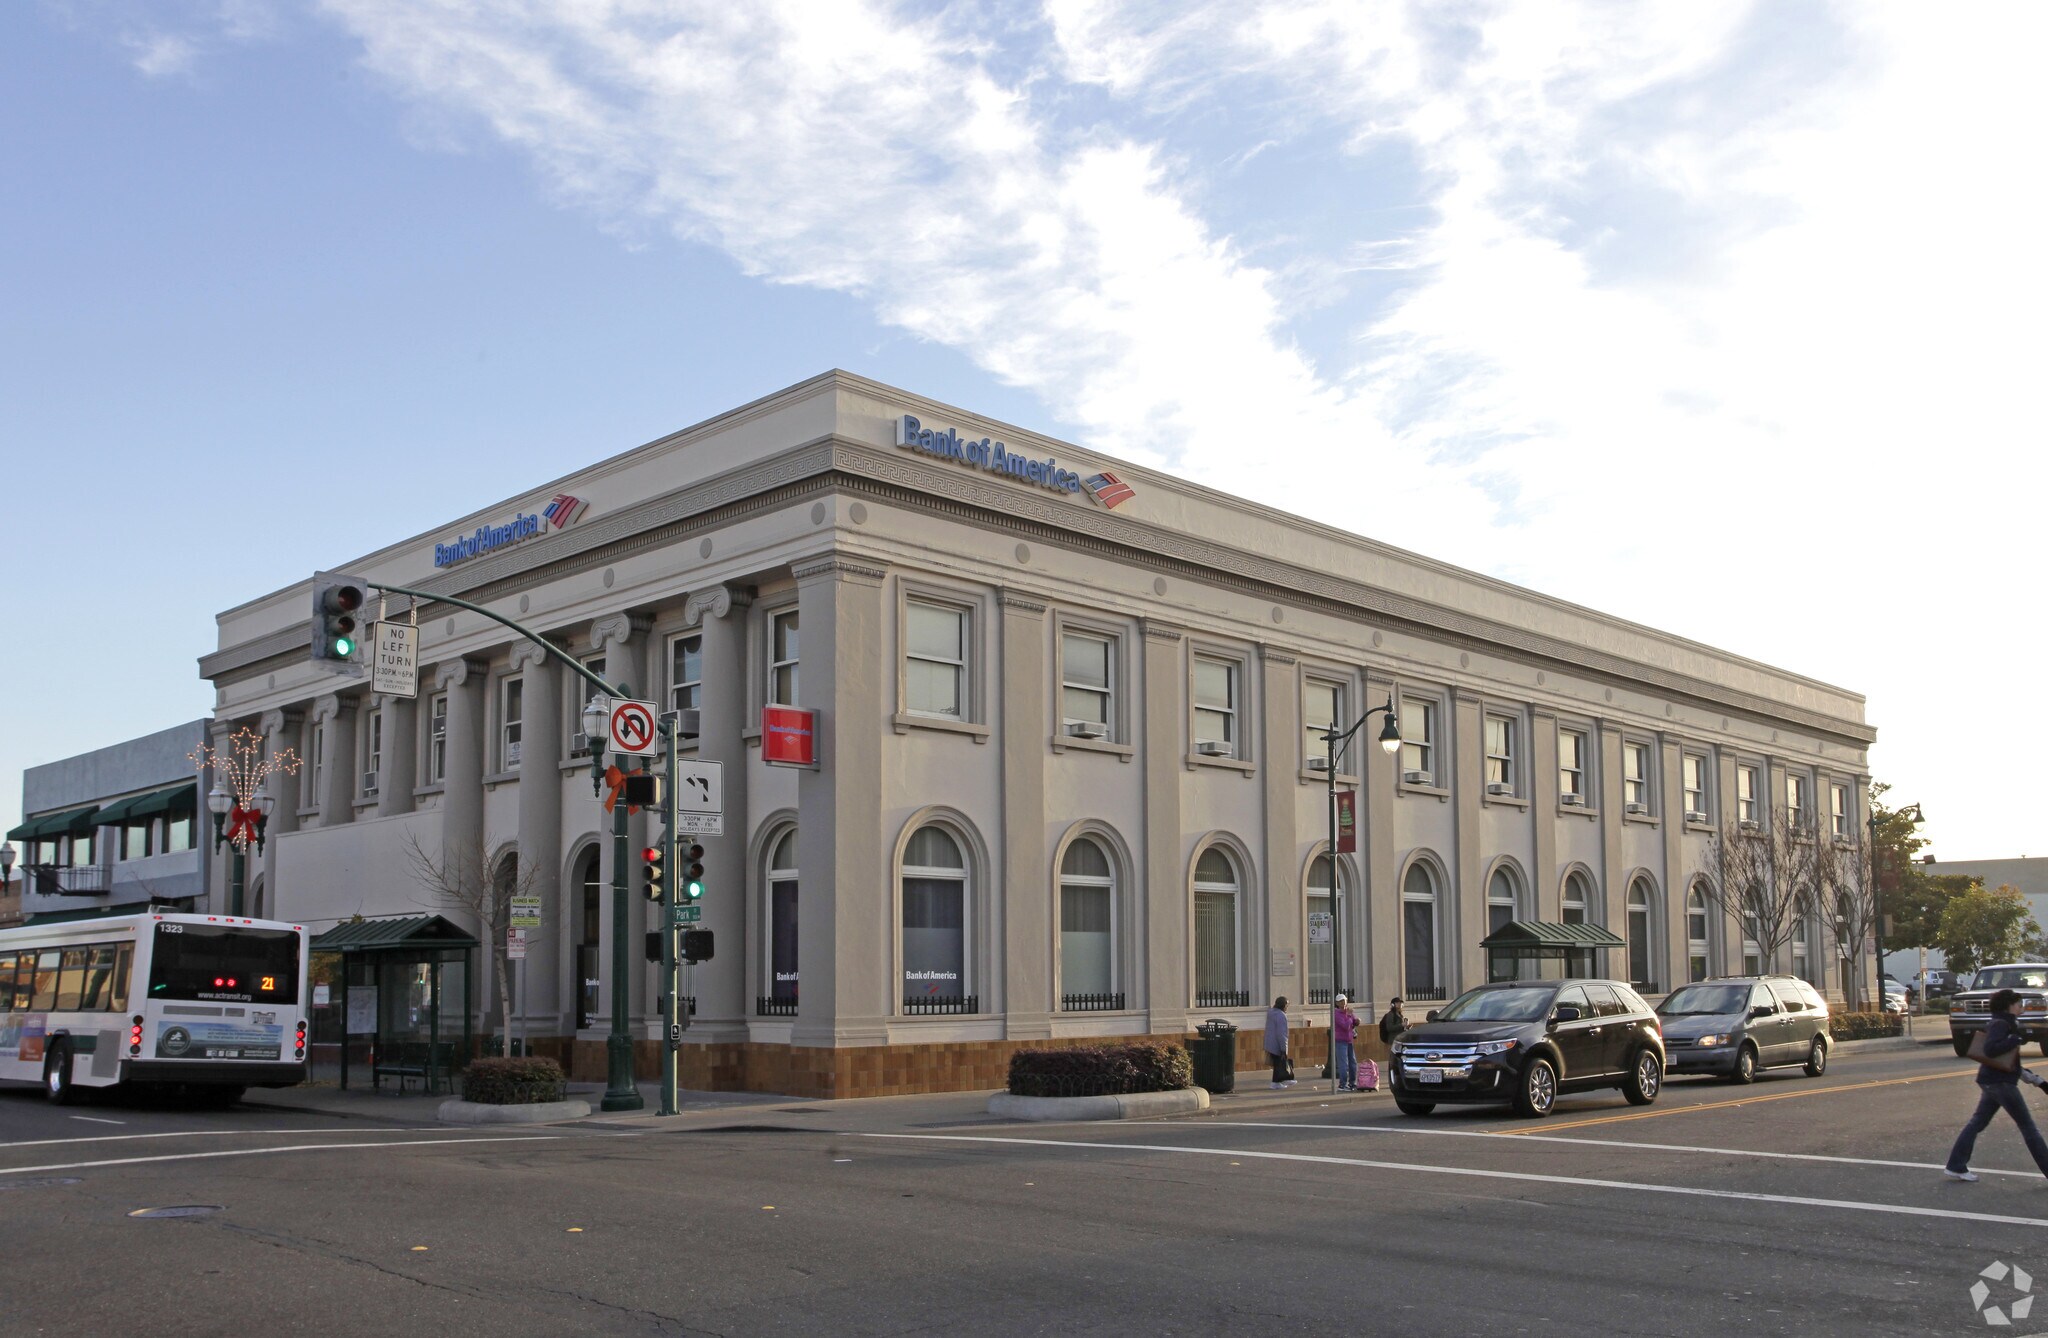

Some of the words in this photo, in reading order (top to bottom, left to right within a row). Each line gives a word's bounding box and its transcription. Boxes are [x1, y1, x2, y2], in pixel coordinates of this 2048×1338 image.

[903, 414, 964, 459] Bank
[966, 437, 991, 468] of
[991, 441, 1080, 494] America
[434, 535, 468, 568] Bank
[466, 526, 482, 556] of
[481, 512, 538, 551] America
[390, 629, 405, 639] NO
[382, 641, 411, 653] LEFT
[381, 654, 412, 667] TURN
[676, 909, 690, 920] Park
[160, 923, 183, 934] 1323
[776, 972, 790, 981] Bank
[790, 972, 796, 981] of
[905, 970, 923, 980] Bank
[922, 970, 930, 980] of
[930, 970, 957, 980] America
[261, 976, 274, 990] 21
[585, 978, 597, 986] Bank
[198, 991, 252, 1001] www.actransit.org
